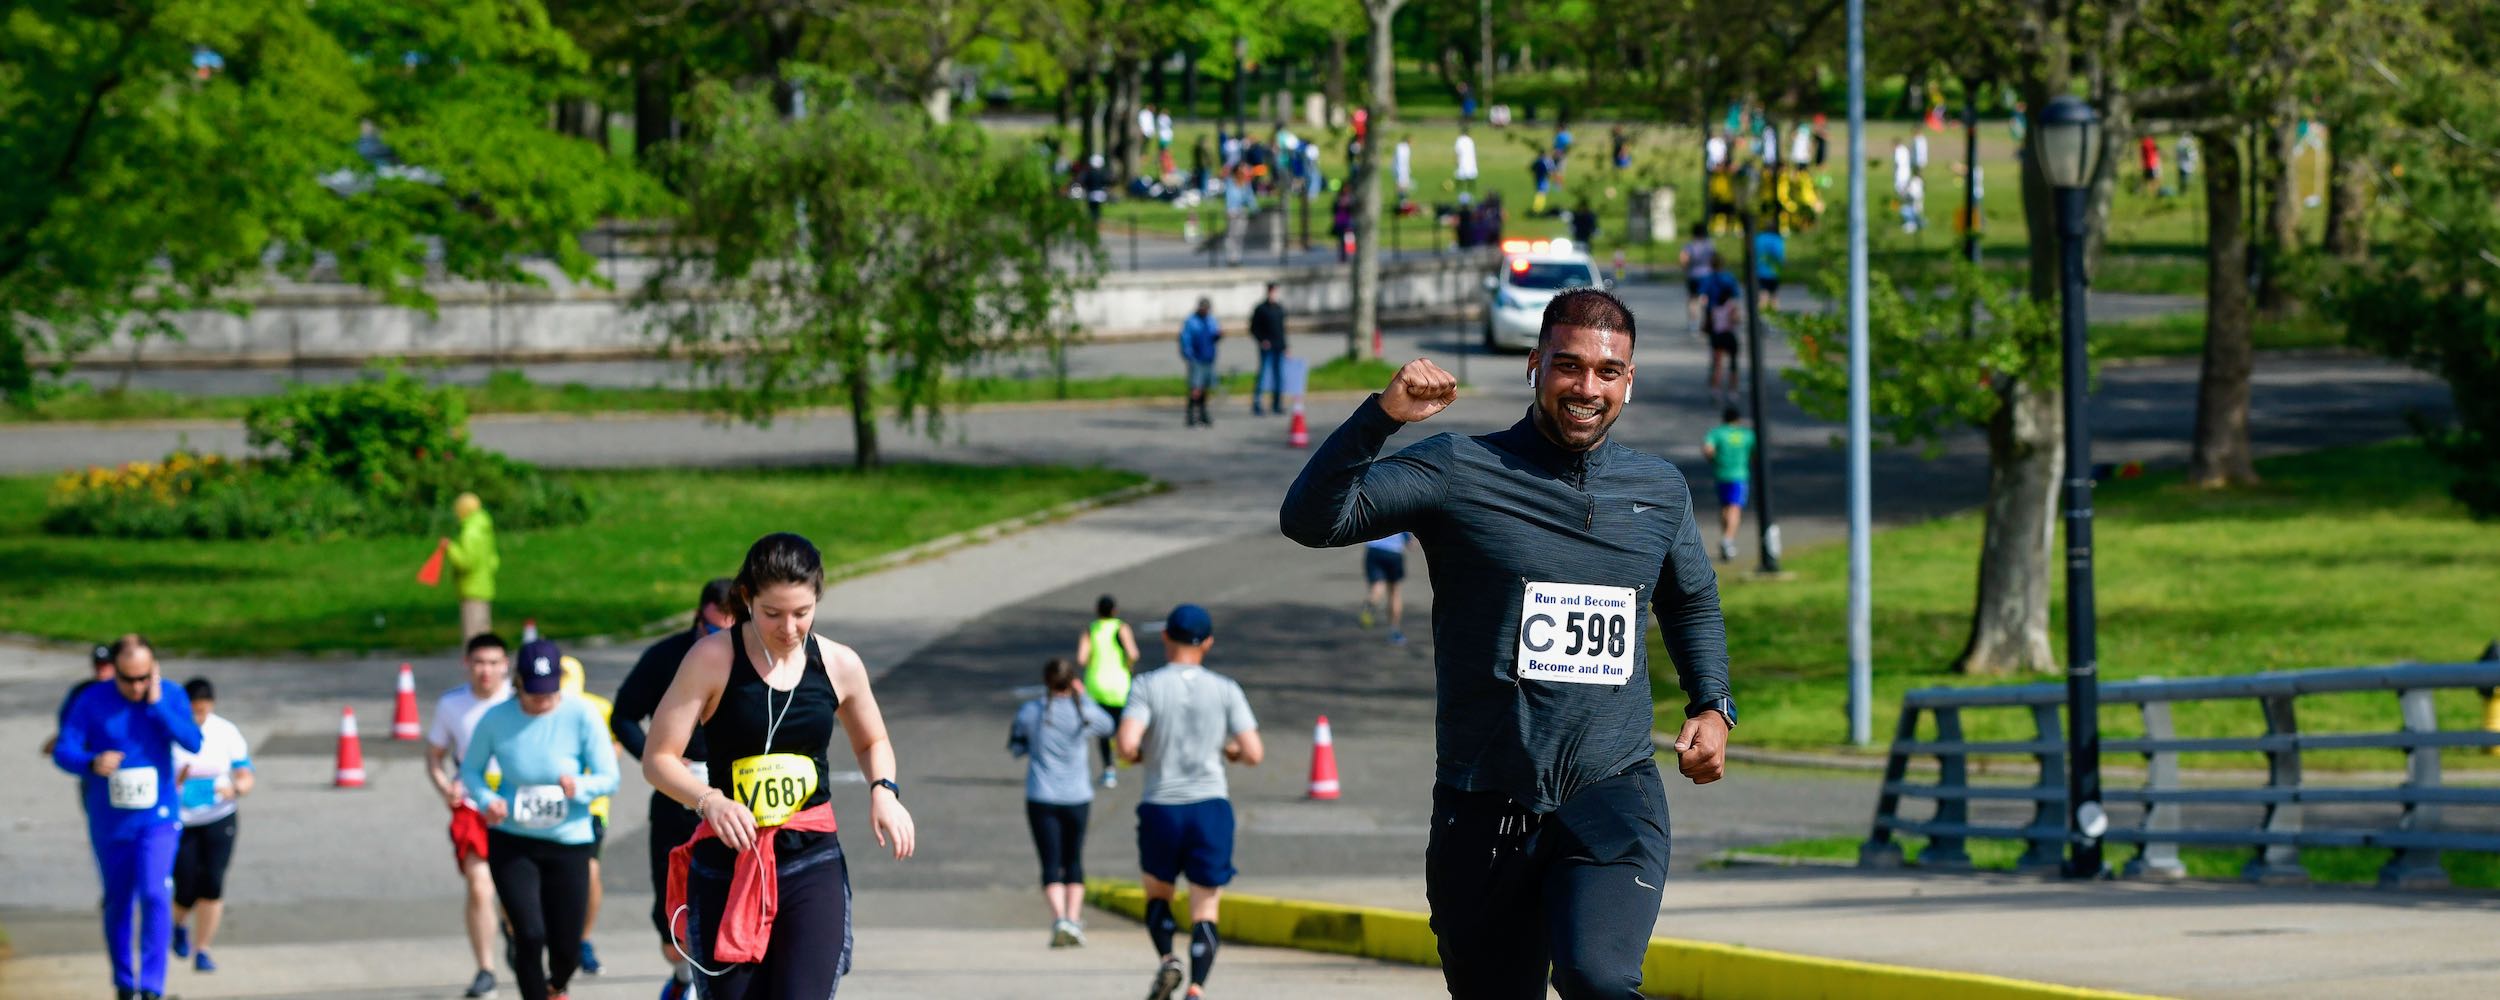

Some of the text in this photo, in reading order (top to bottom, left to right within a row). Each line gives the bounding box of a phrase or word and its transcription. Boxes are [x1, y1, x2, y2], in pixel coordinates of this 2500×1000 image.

[1535, 593, 1626, 608] Run and Become
[1529, 660, 1623, 675] Become and Run
